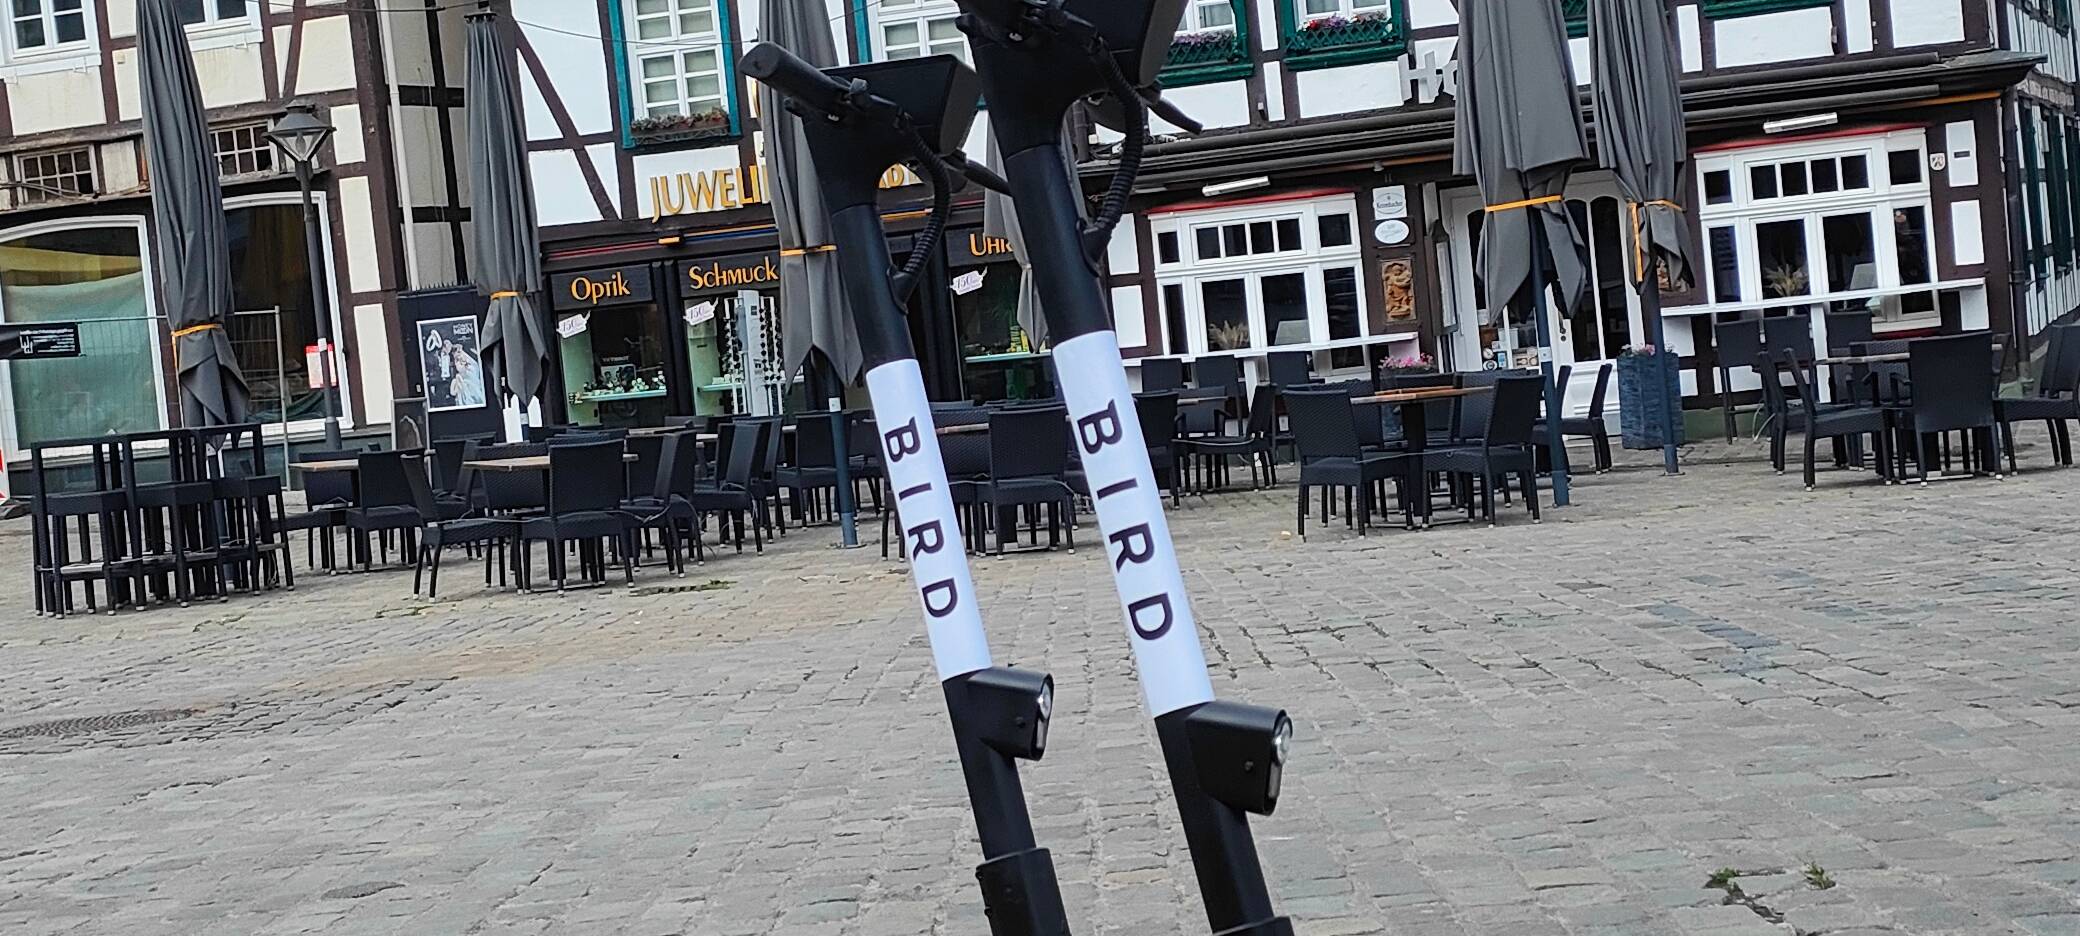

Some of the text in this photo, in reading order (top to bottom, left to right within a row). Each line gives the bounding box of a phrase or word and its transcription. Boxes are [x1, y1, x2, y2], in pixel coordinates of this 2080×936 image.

[571, 272, 631, 304] Optik
[689, 256, 779, 289] Schmuck
[884, 416, 958, 618] BIRD
[1077, 399, 1174, 641] BIRD
